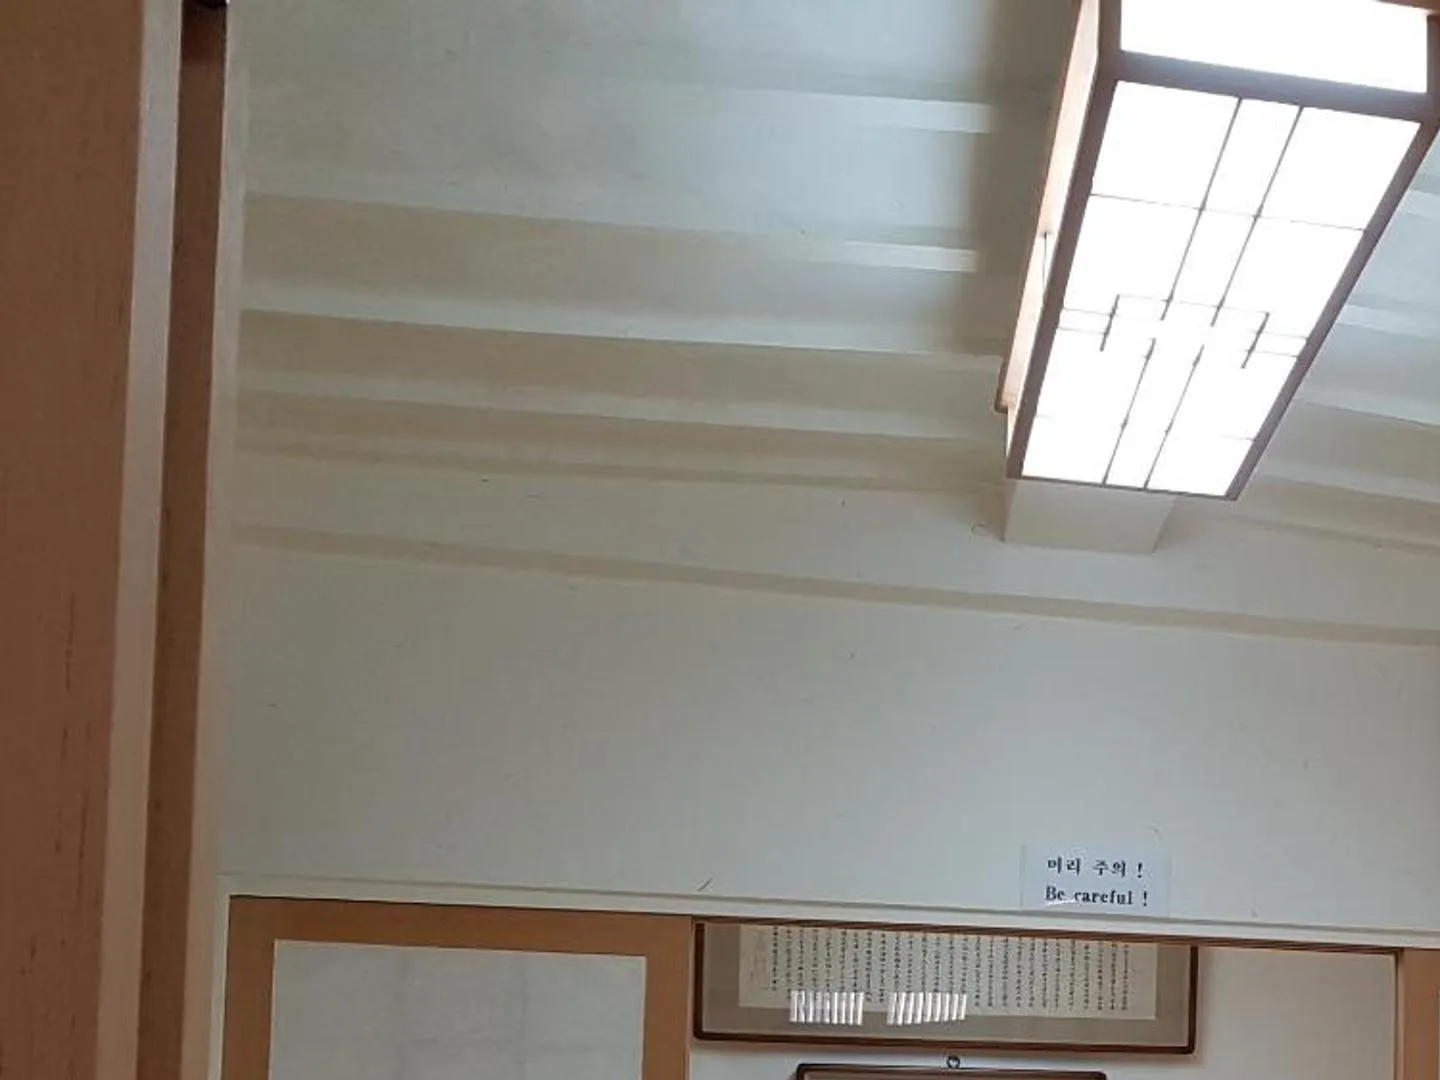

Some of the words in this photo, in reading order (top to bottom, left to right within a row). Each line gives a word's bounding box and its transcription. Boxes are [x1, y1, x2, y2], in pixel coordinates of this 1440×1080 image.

[1046, 855, 1082, 876] 머리
[1092, 858, 1127, 878] 주의
[1045, 885, 1065, 901] Be
[1074, 889, 1133, 905] careful
